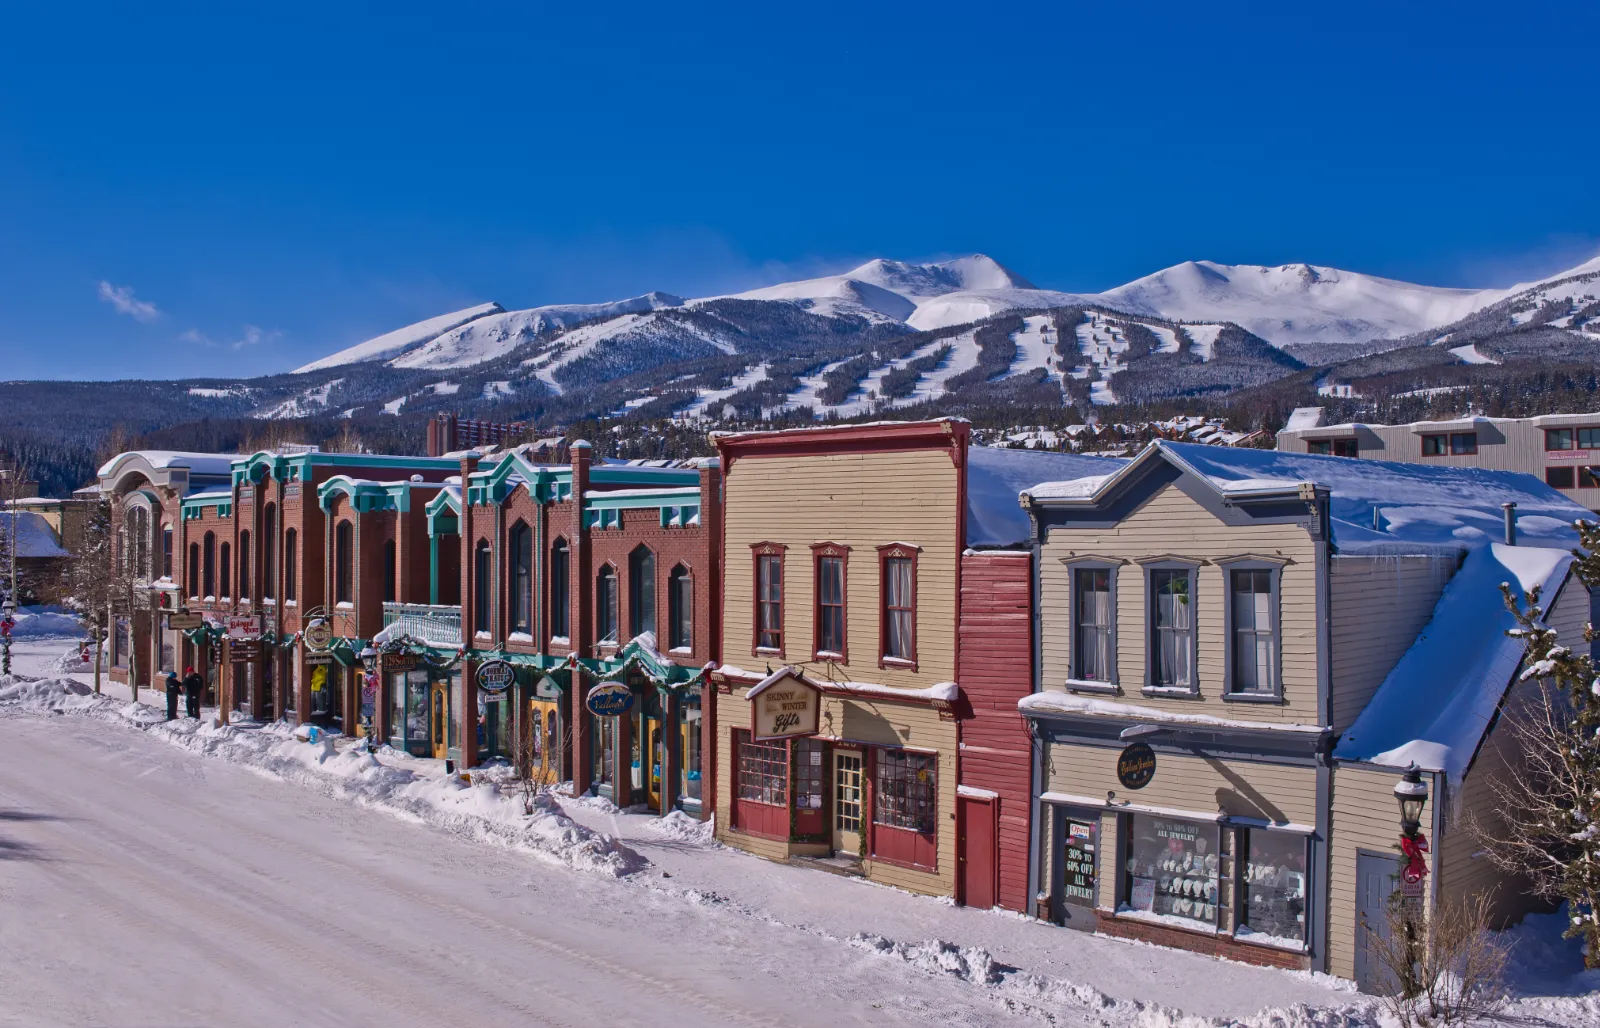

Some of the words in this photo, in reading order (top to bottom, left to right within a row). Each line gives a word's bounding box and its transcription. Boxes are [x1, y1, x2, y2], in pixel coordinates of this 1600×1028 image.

[766, 691, 795, 702] SKINNY
[781, 701, 807, 711] WINTER
[772, 712, 800, 734] Gifts
[1071, 824, 1089, 835] Open
[1169, 831, 1195, 842] JEWELRY
[1068, 848, 1082, 860] 30%
[1084, 853, 1092, 862] TO
[1066, 861, 1080, 873] 60%
[1080, 863, 1093, 875] OFF
[1074, 874, 1085, 885] ALL
[1066, 884, 1093, 900] JEWELRY
